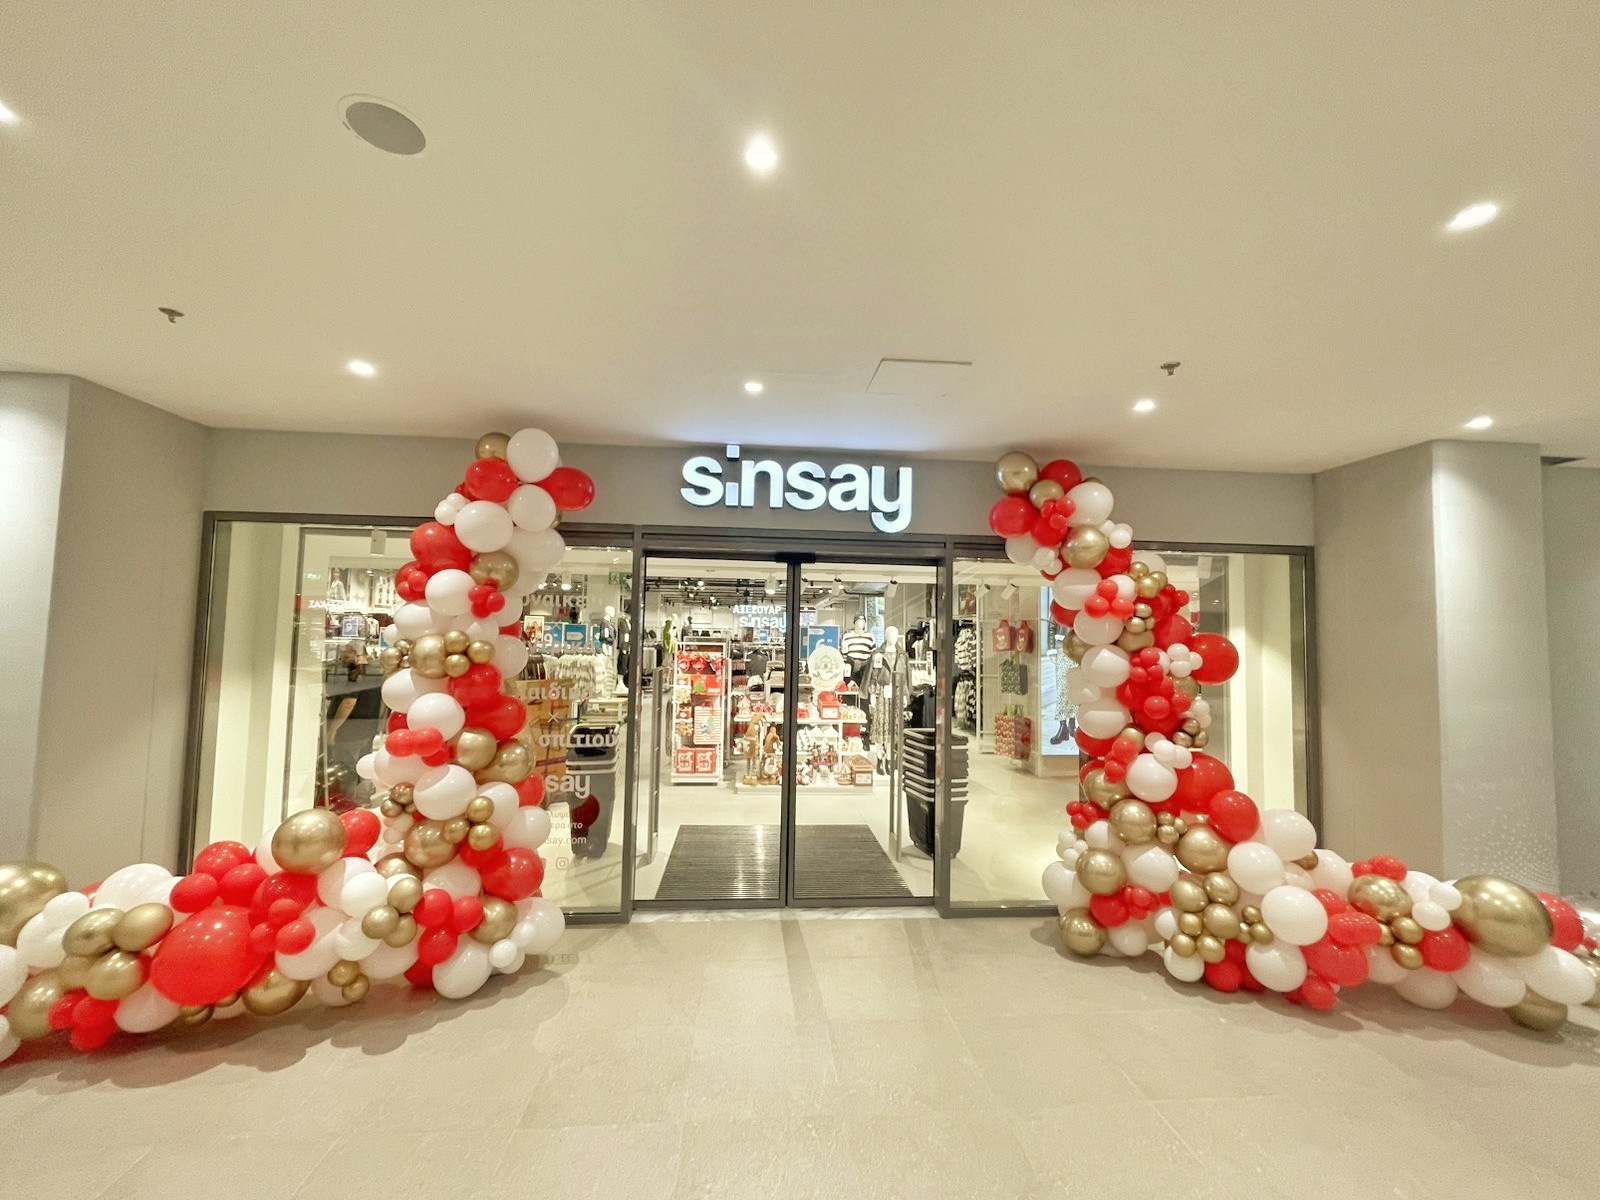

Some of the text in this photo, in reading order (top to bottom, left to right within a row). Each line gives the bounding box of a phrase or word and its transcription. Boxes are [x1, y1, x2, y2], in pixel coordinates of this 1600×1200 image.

[680, 444, 913, 533] sinsay
[739, 612, 787, 633] sinsay
[545, 774, 591, 799] say
